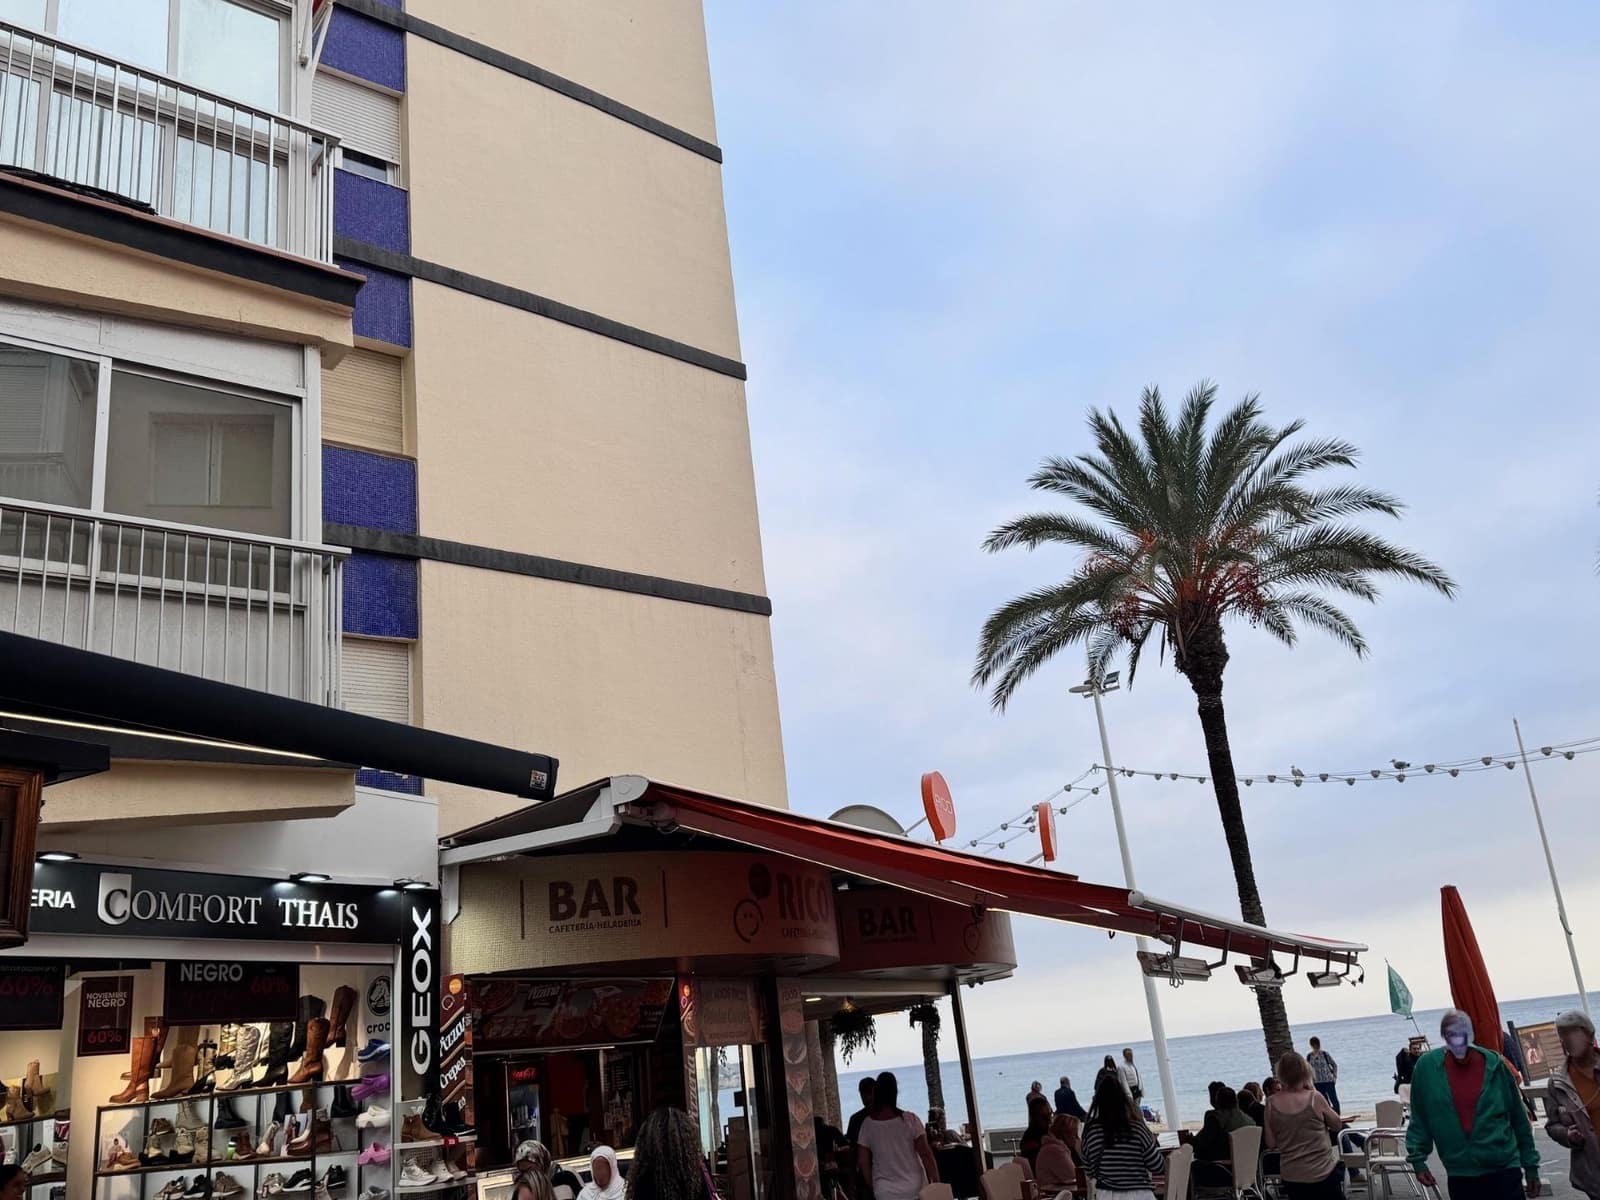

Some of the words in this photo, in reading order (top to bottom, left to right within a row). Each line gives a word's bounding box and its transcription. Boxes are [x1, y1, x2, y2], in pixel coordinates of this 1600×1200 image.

[104, 888, 262, 926] COMFORT
[278, 897, 359, 930] THAIS
[549, 876, 641, 921] BAR
[777, 871, 831, 922] RICO
[858, 906, 918, 937] BAR
[179, 962, 244, 983] NEGRO
[410, 906, 433, 1076] GEOX
[87, 998, 127, 1009] NEGRO
